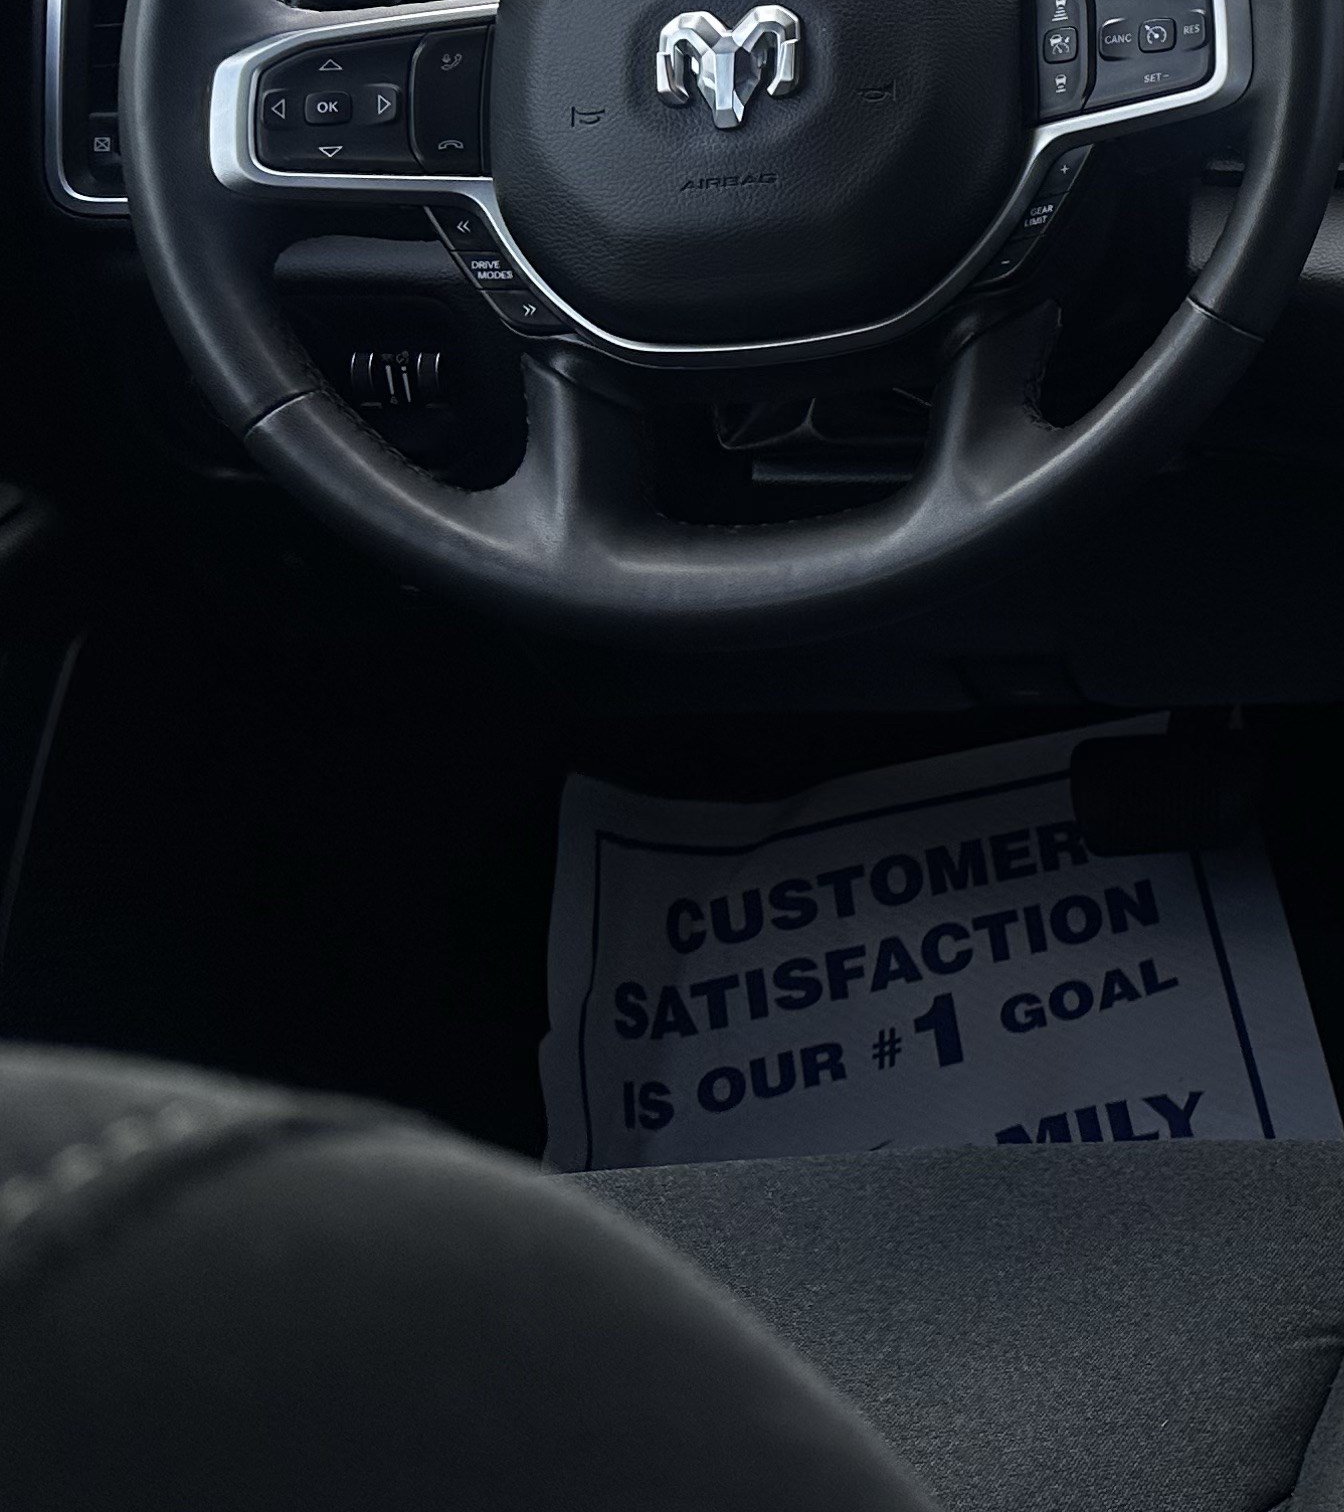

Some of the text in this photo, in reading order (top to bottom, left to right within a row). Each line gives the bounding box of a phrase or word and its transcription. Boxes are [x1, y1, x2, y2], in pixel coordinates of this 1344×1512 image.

[1184, 24, 1201, 35] RES
[1105, 33, 1132, 44] CANC
[317, 101, 338, 113] OK
[1031, 204, 1053, 215] GEAR
[471, 260, 500, 269] DRIVE
[477, 270, 513, 279] MODES
[665, 820, 1090, 954] CUSTOMER
[614, 879, 1160, 1041] SATISFACTION
[623, 1081, 675, 1132] IS
[696, 1042, 848, 1115] OUR
[999, 958, 1179, 1034] GOAL
